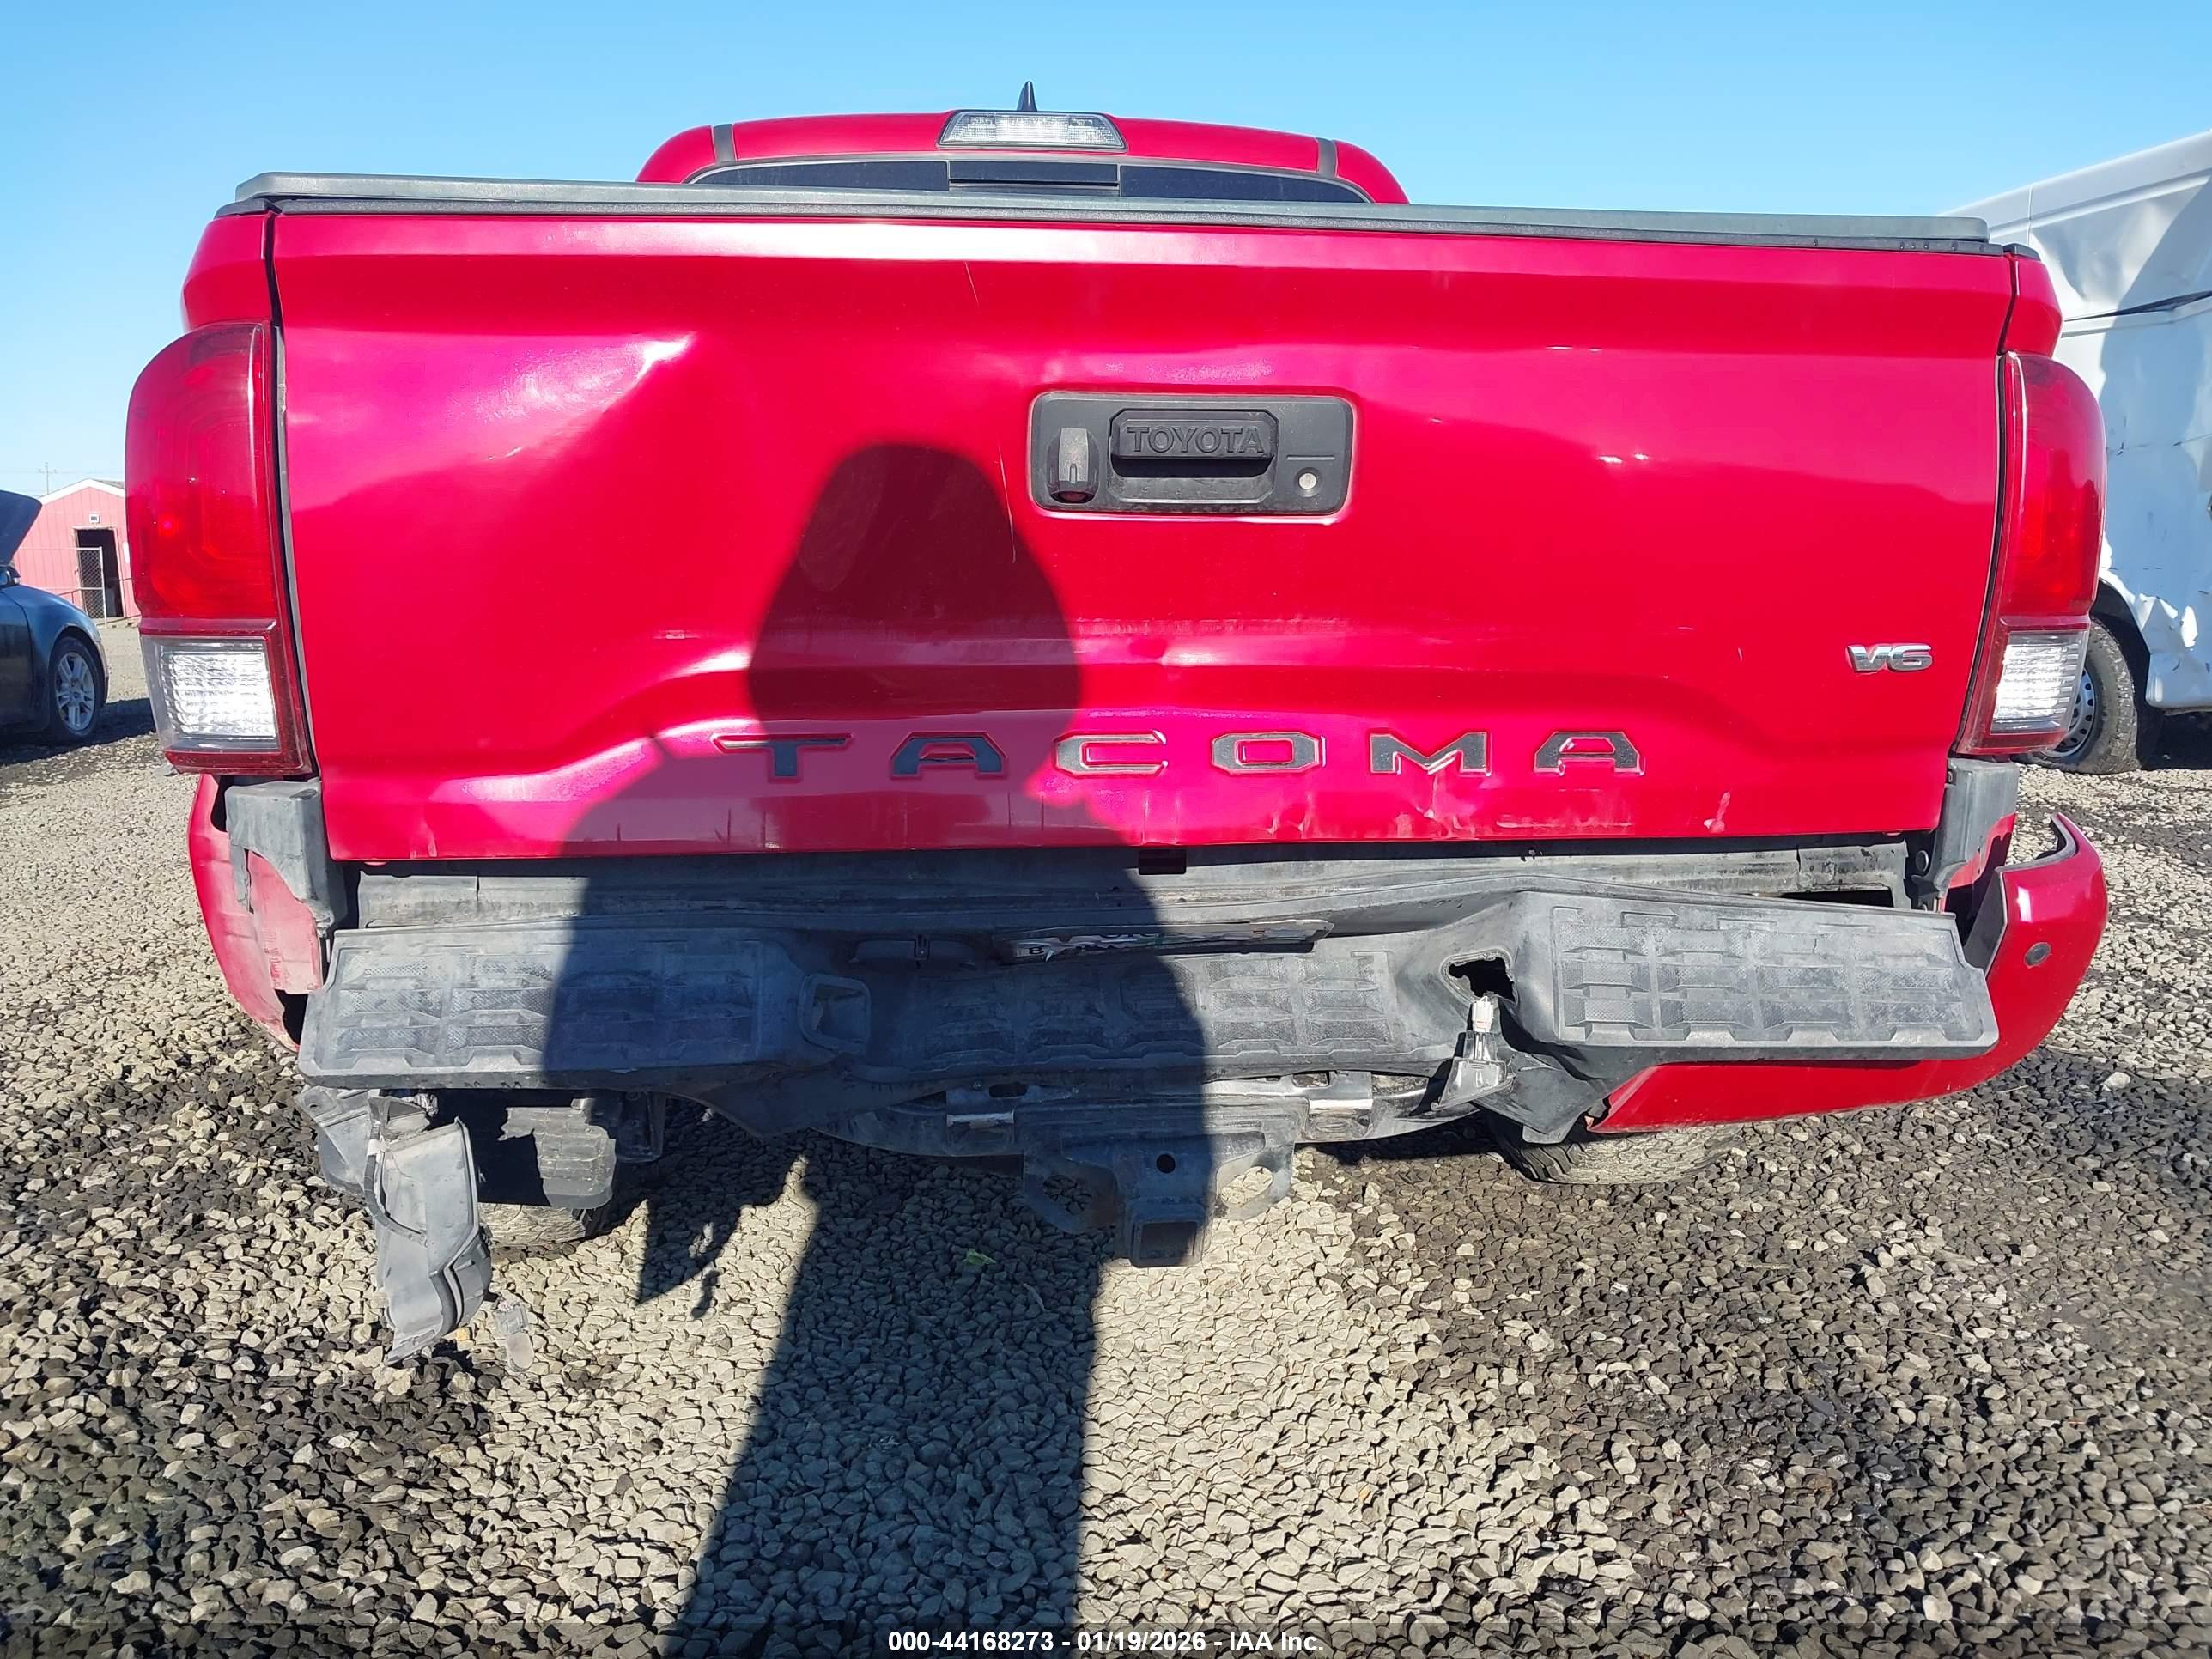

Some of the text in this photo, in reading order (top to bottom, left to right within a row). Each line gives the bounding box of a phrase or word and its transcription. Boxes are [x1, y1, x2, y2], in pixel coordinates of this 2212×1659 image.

[1127, 426, 1265, 454] TOYOTA
[1846, 644, 1933, 672] V6
[712, 731, 1644, 778] TACOMA
